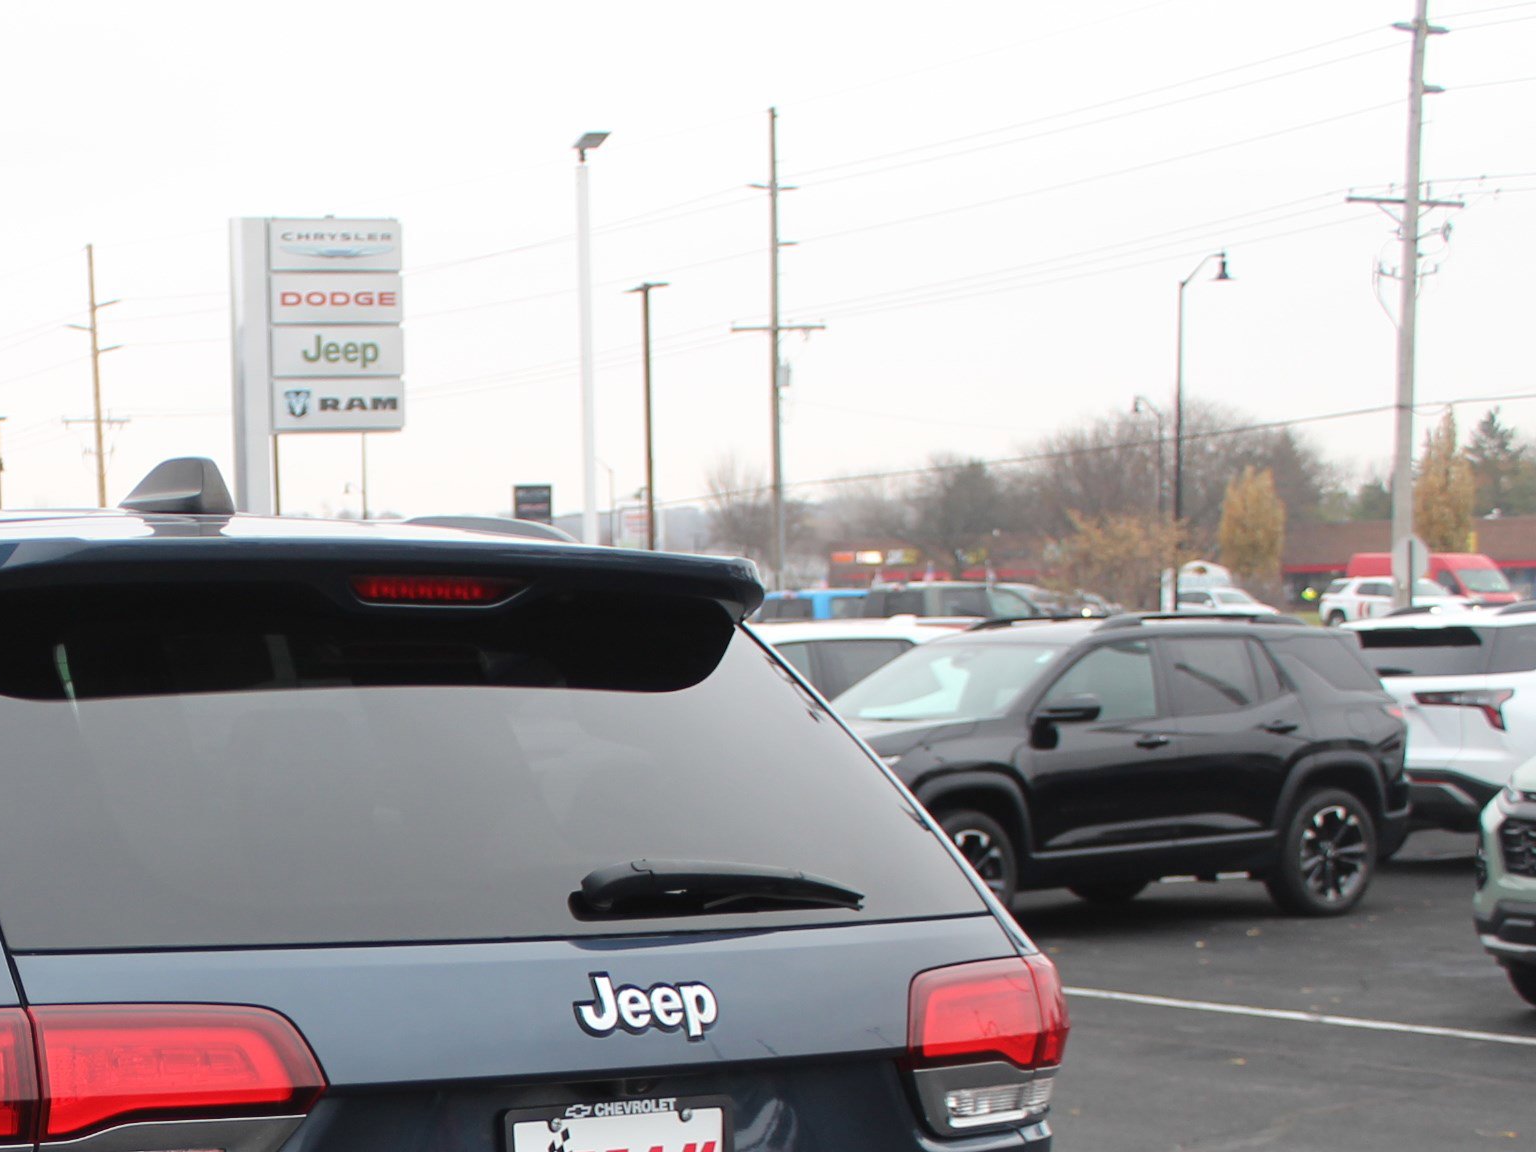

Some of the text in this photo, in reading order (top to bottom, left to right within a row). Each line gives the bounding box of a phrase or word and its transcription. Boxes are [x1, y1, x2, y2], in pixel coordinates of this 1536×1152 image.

[280, 231, 393, 242] CHRYSLER
[280, 291, 397, 307] DODGE
[302, 334, 379, 369] Jeep
[319, 396, 399, 412] RAM
[573, 971, 719, 1041] Jeep
[594, 1097, 677, 1117] CHEVROLET
